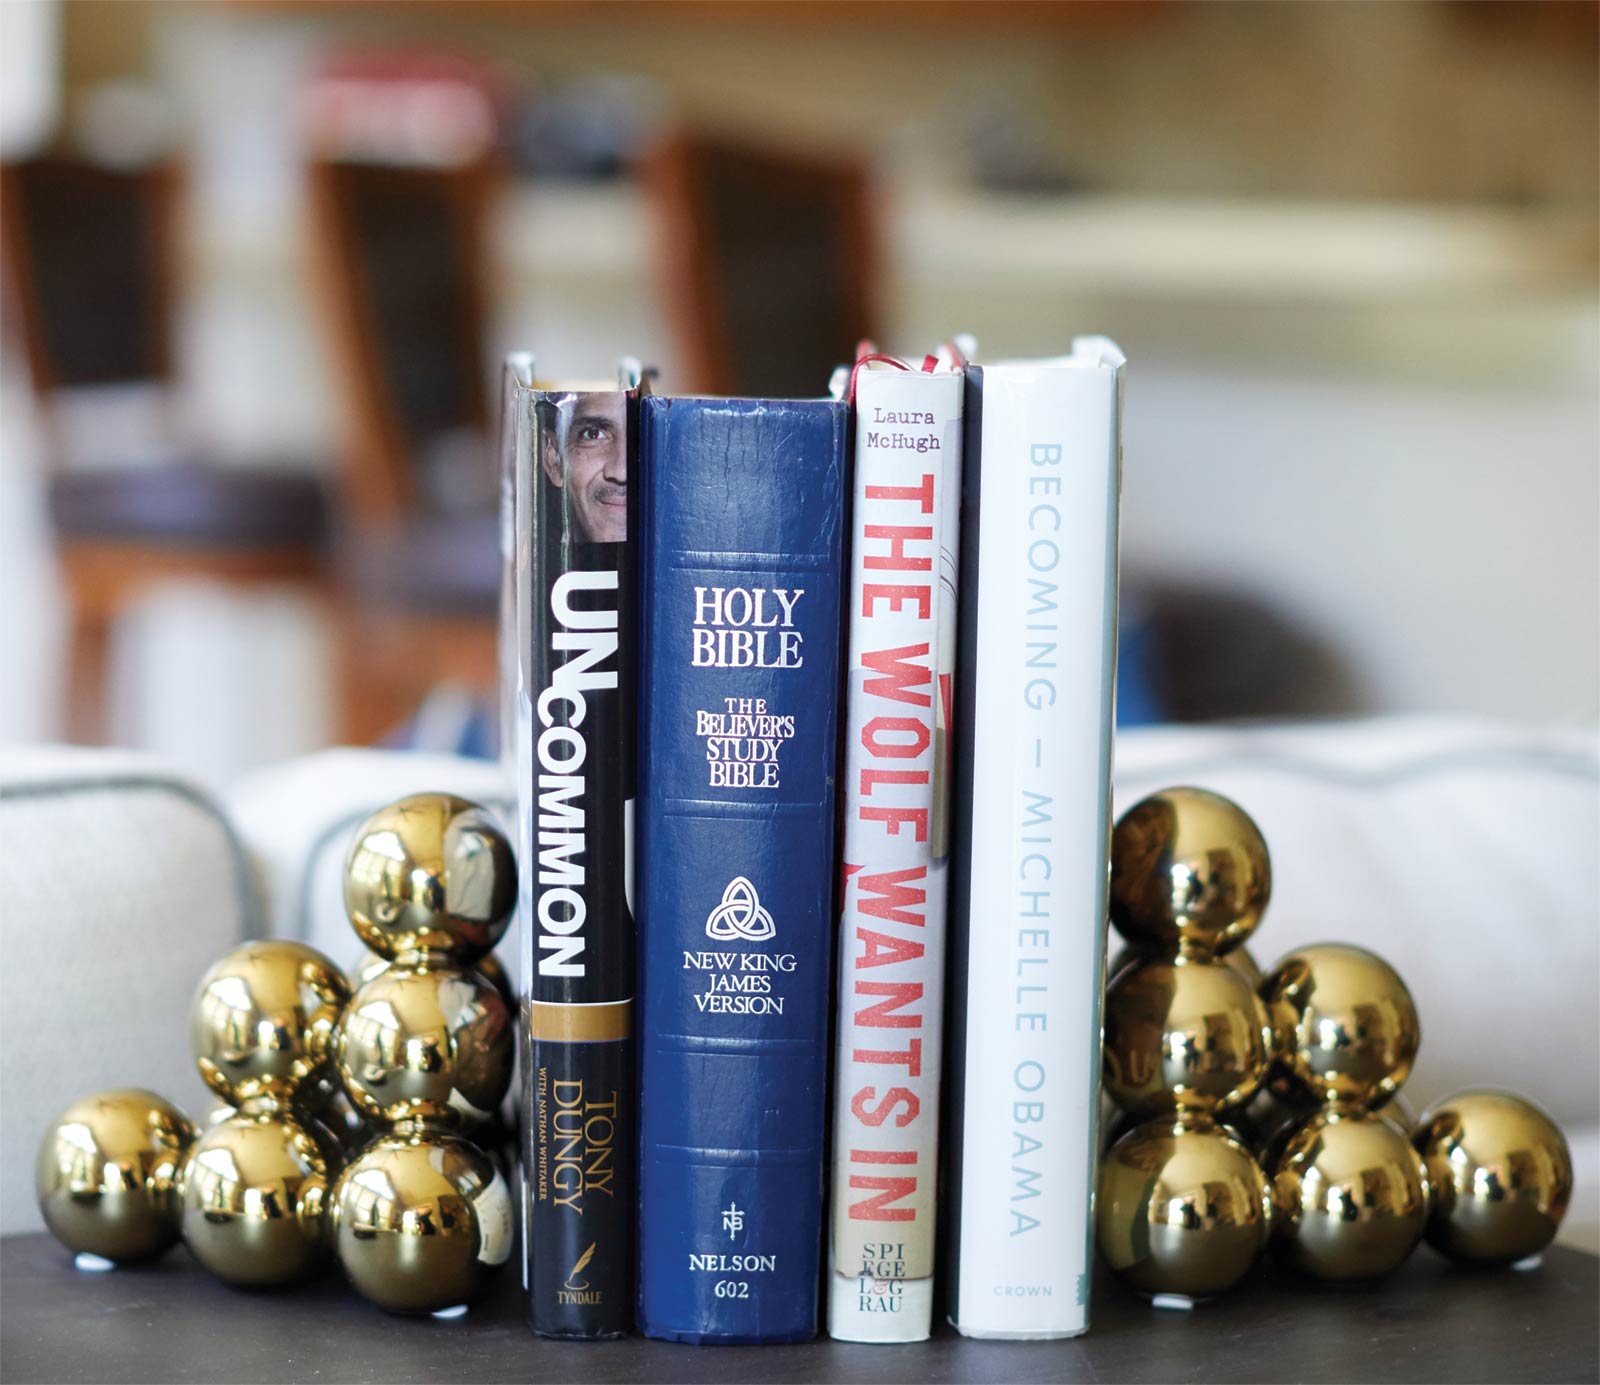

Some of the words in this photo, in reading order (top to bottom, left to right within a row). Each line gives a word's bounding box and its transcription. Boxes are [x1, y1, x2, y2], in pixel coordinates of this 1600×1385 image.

[873, 407, 935, 425] Laura
[867, 433, 941, 453] McHugh
[862, 473, 935, 620] THE
[1023, 443, 1062, 711] BECOMING
[693, 586, 805, 627] HOLY
[691, 629, 804, 669] BIBLE
[724, 697, 767, 714] THE
[696, 710, 795, 738] BELIEVER'S
[706, 736, 784, 762] STUDY
[859, 642, 933, 843] WOLF
[536, 571, 619, 977] UNCOMMON
[708, 761, 780, 788] BIBLE
[1015, 790, 1054, 1032] MICHELLE
[682, 951, 737, 970] NEW
[739, 953, 797, 972] KING
[704, 973, 772, 998] JAMES
[850, 865, 928, 1128] WANTS
[693, 994, 785, 1015] VERSION
[538, 1066, 547, 1100] WITH
[538, 1101, 547, 1144] NATHAN
[553, 1078, 583, 1216] DUNGY
[585, 1090, 618, 1197] TONY
[1009, 1060, 1047, 1238] OBAMA
[538, 1146, 547, 1201] WHITAKER
[848, 1148, 918, 1222] IN
[688, 1253, 777, 1272] NELSON
[862, 1242, 905, 1260] SPI
[557, 1291, 603, 1305] TYNDALE
[714, 1280, 749, 1298] 602
[858, 1295, 903, 1313] RAU
[993, 1285, 1053, 1297] CROWN
